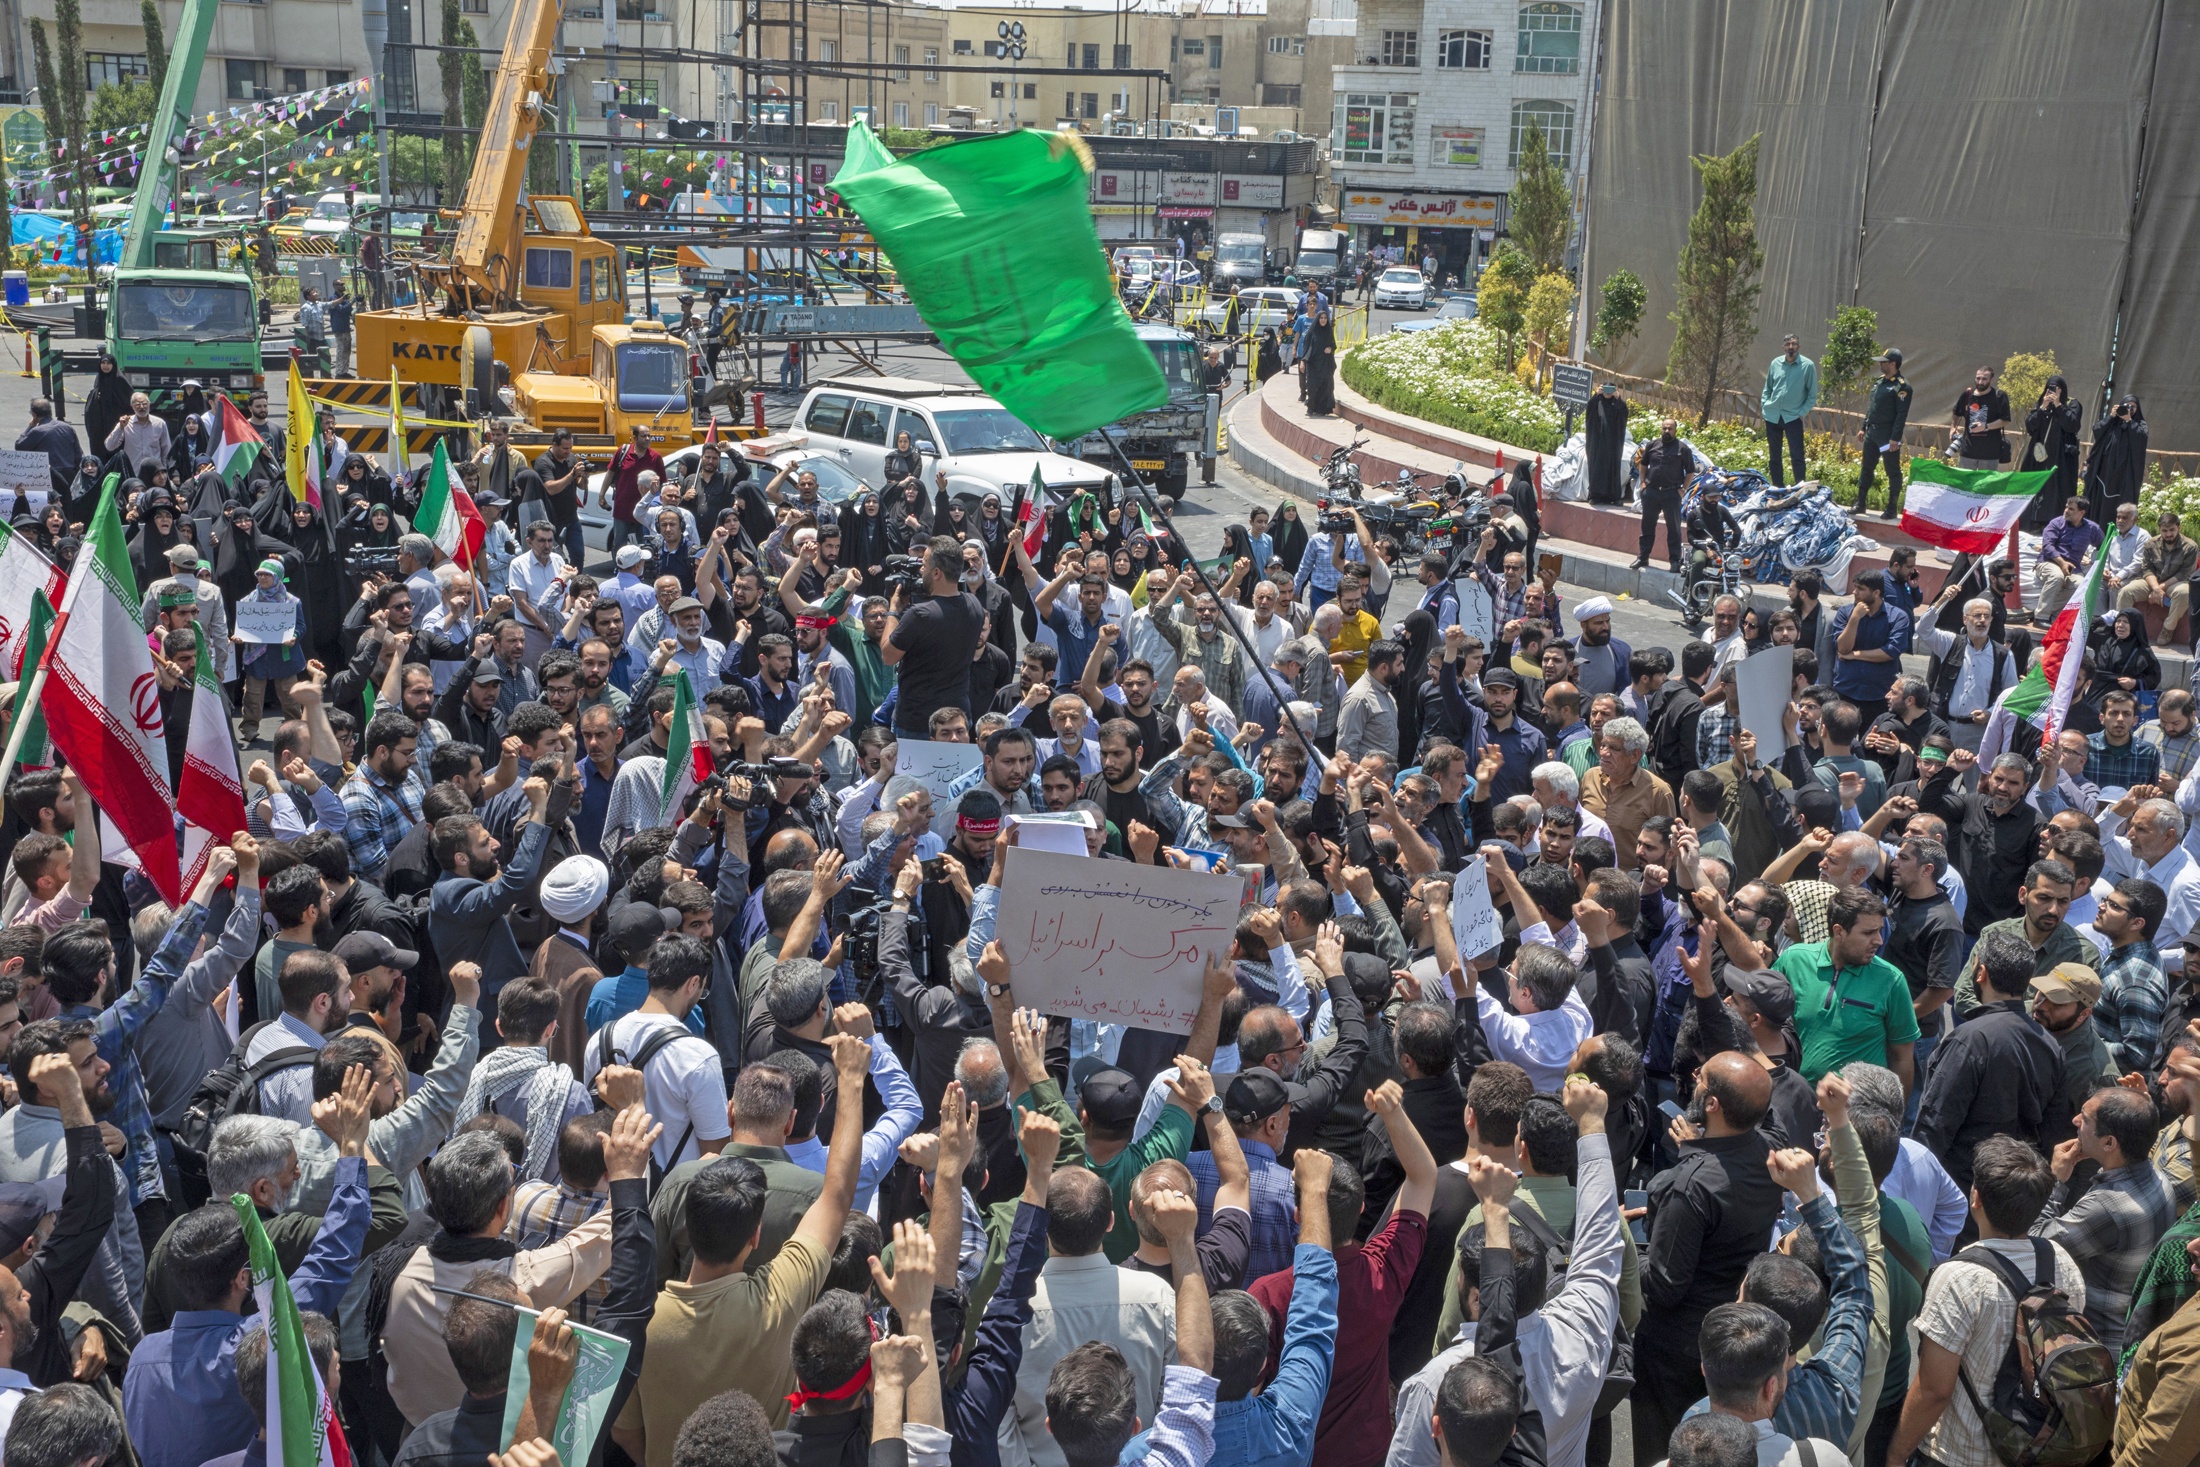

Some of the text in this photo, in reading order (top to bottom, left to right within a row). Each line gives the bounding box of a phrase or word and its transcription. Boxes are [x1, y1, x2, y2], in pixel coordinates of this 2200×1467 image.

[1389, 199, 1418, 213] کتاب
[1421, 199, 1456, 215] آژانس
[1383, 213, 1410, 224] کتاب
[1449, 214, 1493, 227] فروشگاه
[901, 756, 913, 770] ولی
[1148, 897, 1191, 914] فرعون
[1006, 910, 1228, 976] مرگ بر اسرائیل
